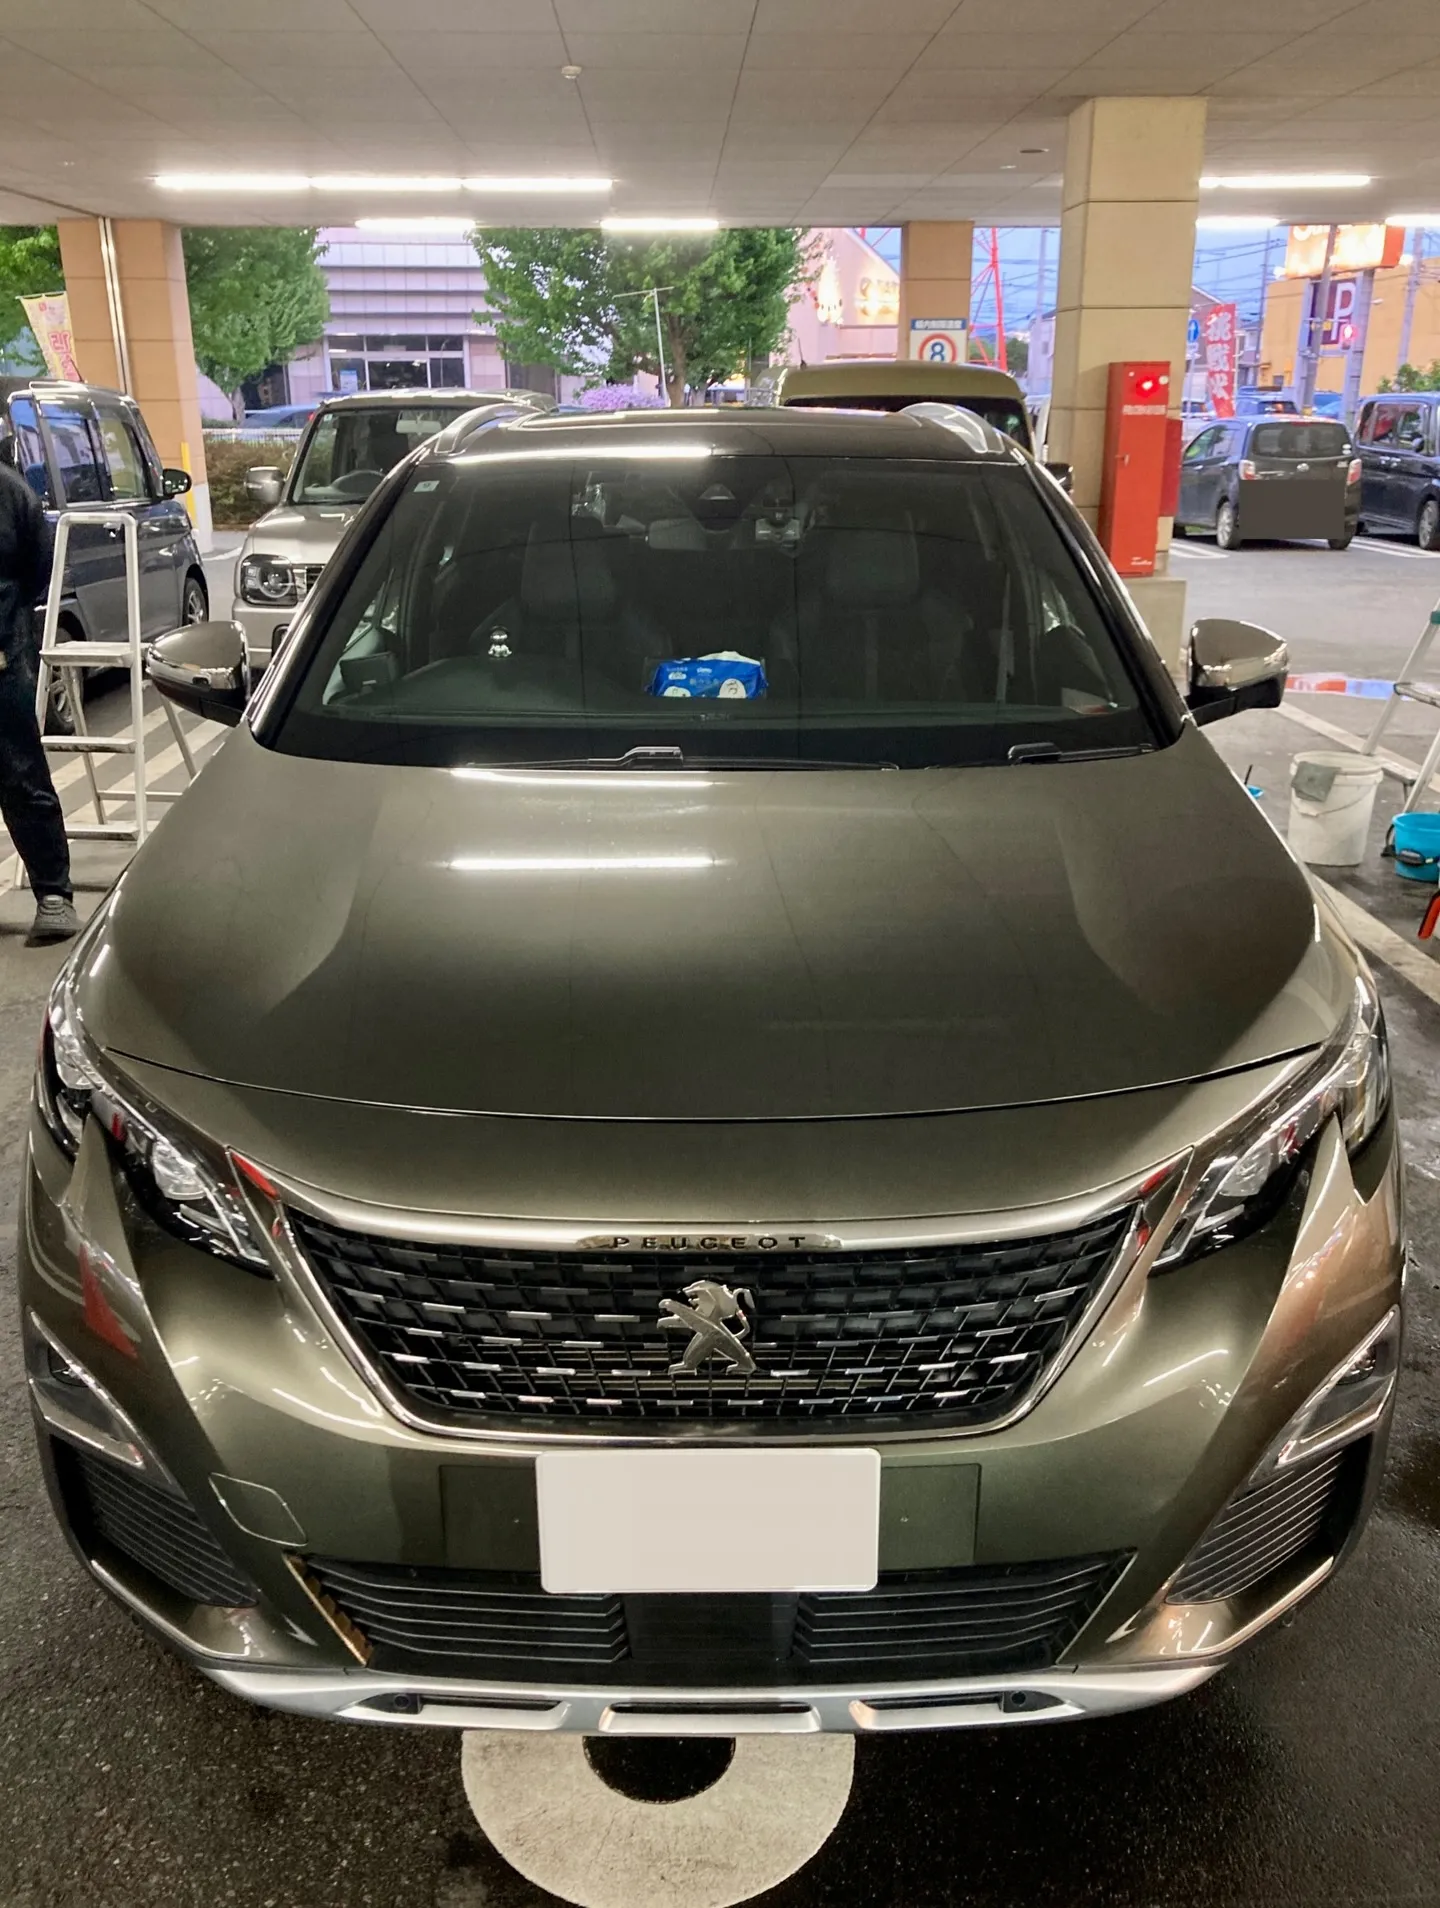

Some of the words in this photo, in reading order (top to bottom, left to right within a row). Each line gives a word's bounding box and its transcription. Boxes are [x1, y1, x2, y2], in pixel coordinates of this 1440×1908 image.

[1331, 282, 1356, 341] P
[930, 341, 945, 361] 8
[613, 1236, 806, 1249] PEUGEOT
